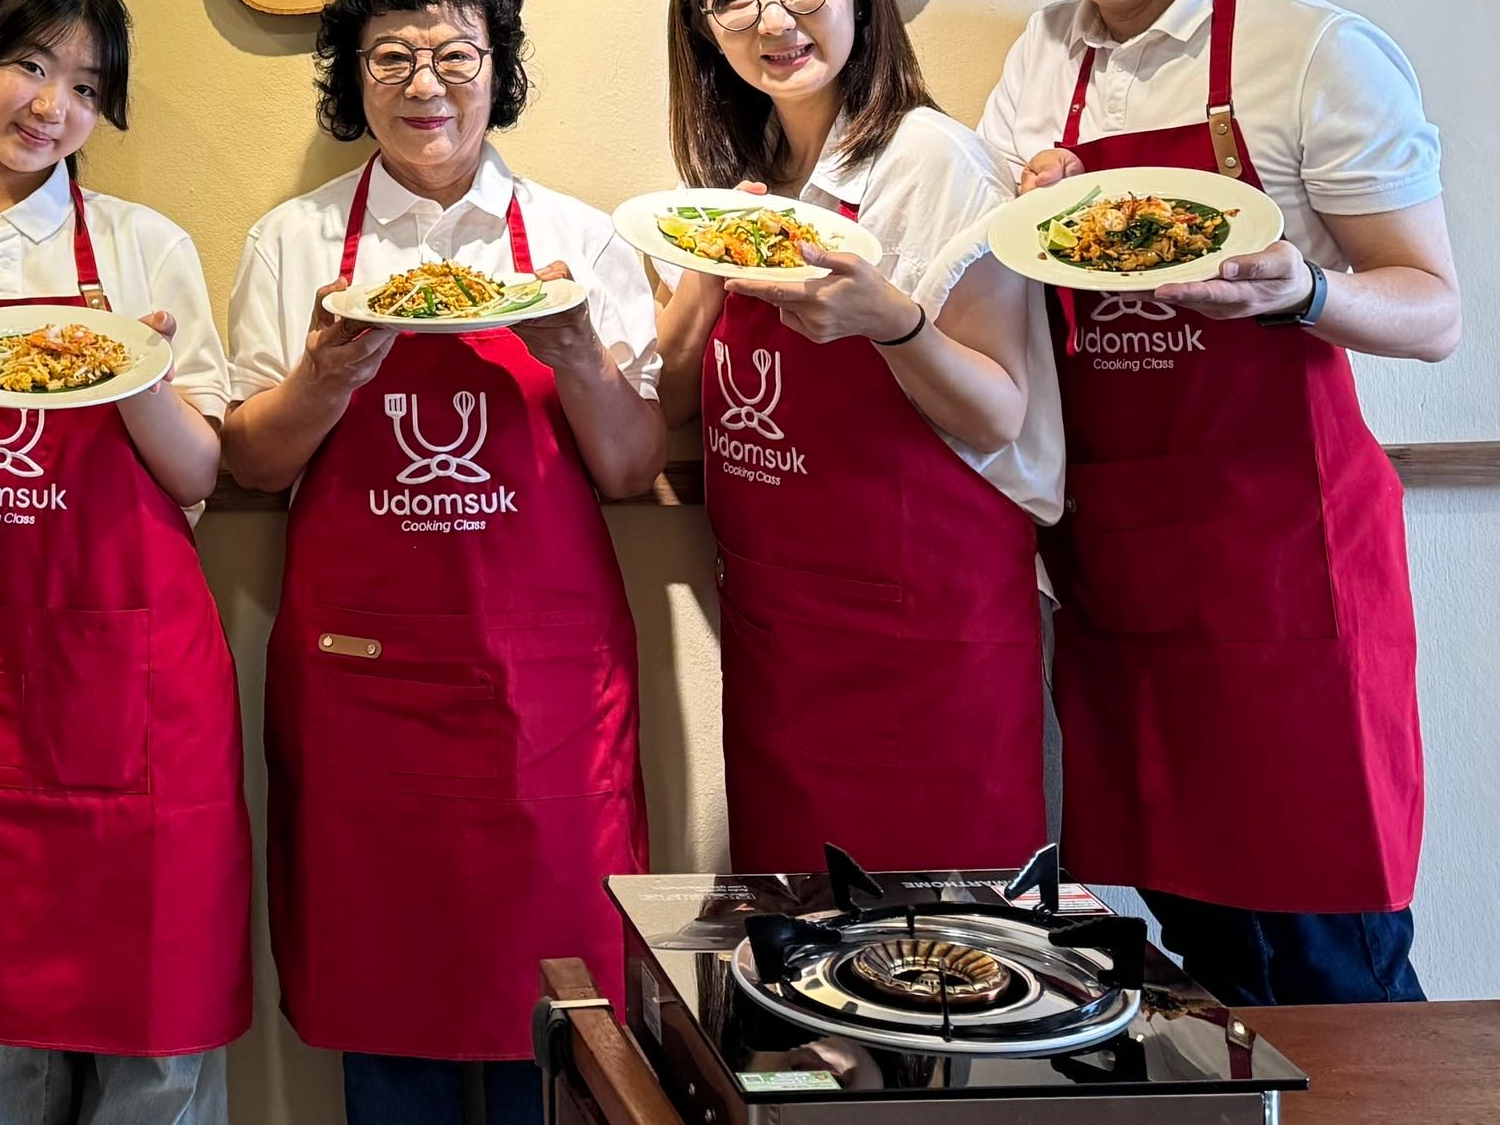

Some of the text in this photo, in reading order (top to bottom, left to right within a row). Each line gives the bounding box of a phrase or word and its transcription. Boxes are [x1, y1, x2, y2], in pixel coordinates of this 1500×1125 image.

[1073, 324, 1206, 354] Udomsuk
[1093, 357, 1174, 372] Cooking Class
[708, 425, 808, 475] Udomsuk
[722, 461, 781, 486] Cooking Class
[369, 485, 518, 516] Udomsuk
[4, 512, 35, 524] Class
[401, 519, 486, 533] Cooking Class
[900, 880, 1012, 889] MARTHOME
